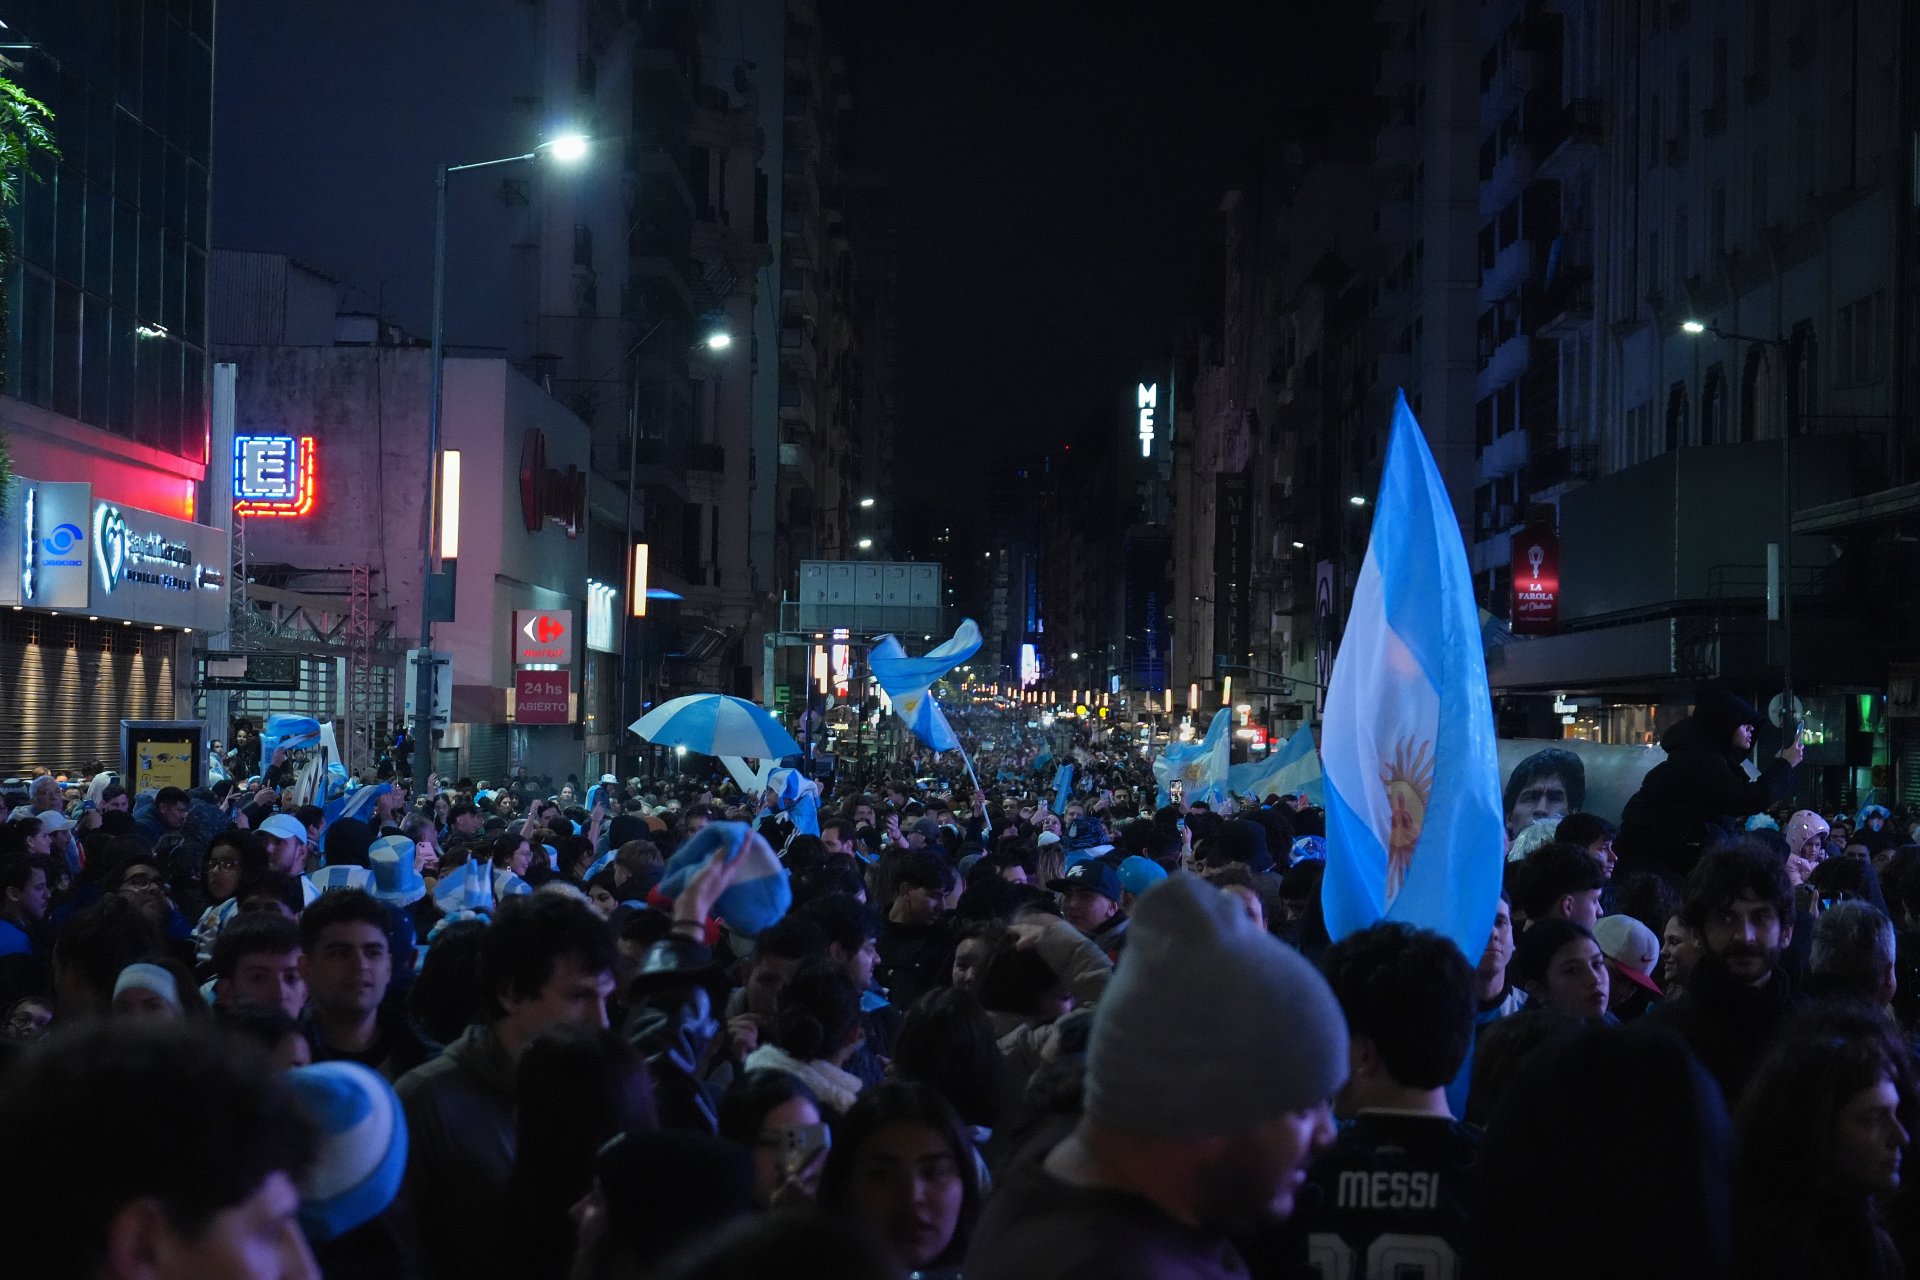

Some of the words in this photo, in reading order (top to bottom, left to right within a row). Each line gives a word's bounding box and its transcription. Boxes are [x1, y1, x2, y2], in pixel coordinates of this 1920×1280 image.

[1139, 383, 1157, 458] MET
[242, 441, 287, 492] E
[1530, 583, 1543, 591] LA
[1518, 592, 1554, 601] FAROLA
[523, 647, 564, 658] market
[524, 682, 543, 695] 24
[545, 682, 563, 695] hs
[775, 686, 790, 703] E
[518, 702, 568, 712] ABIERTO
[1337, 1170, 1441, 1209] MESSI
